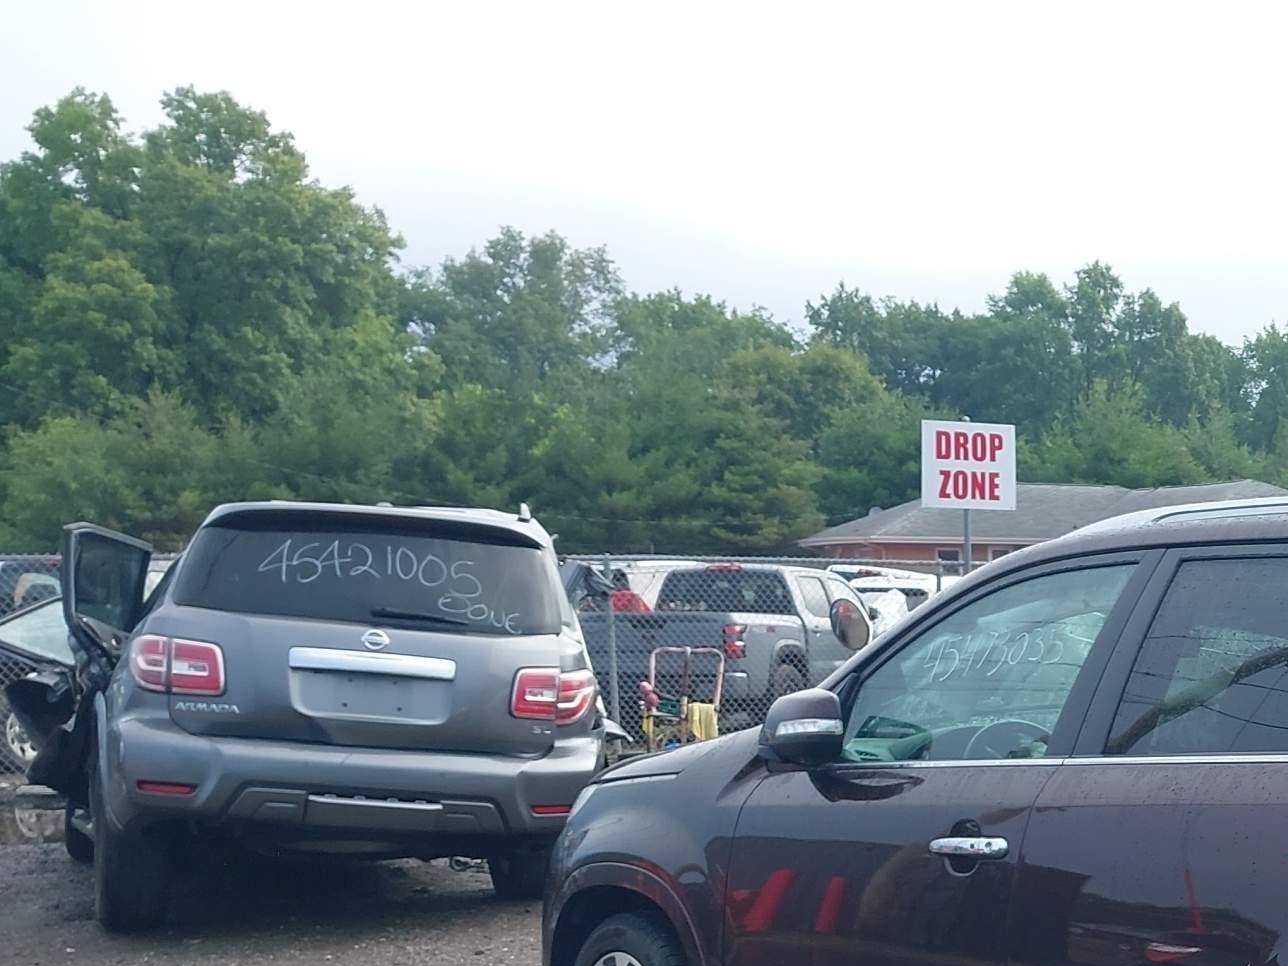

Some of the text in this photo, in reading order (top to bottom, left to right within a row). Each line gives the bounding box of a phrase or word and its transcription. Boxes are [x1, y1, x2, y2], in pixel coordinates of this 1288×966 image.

[935, 430, 1004, 462] DROP
[938, 469, 1001, 501] ZONE
[258, 538, 482, 598] 45421005
